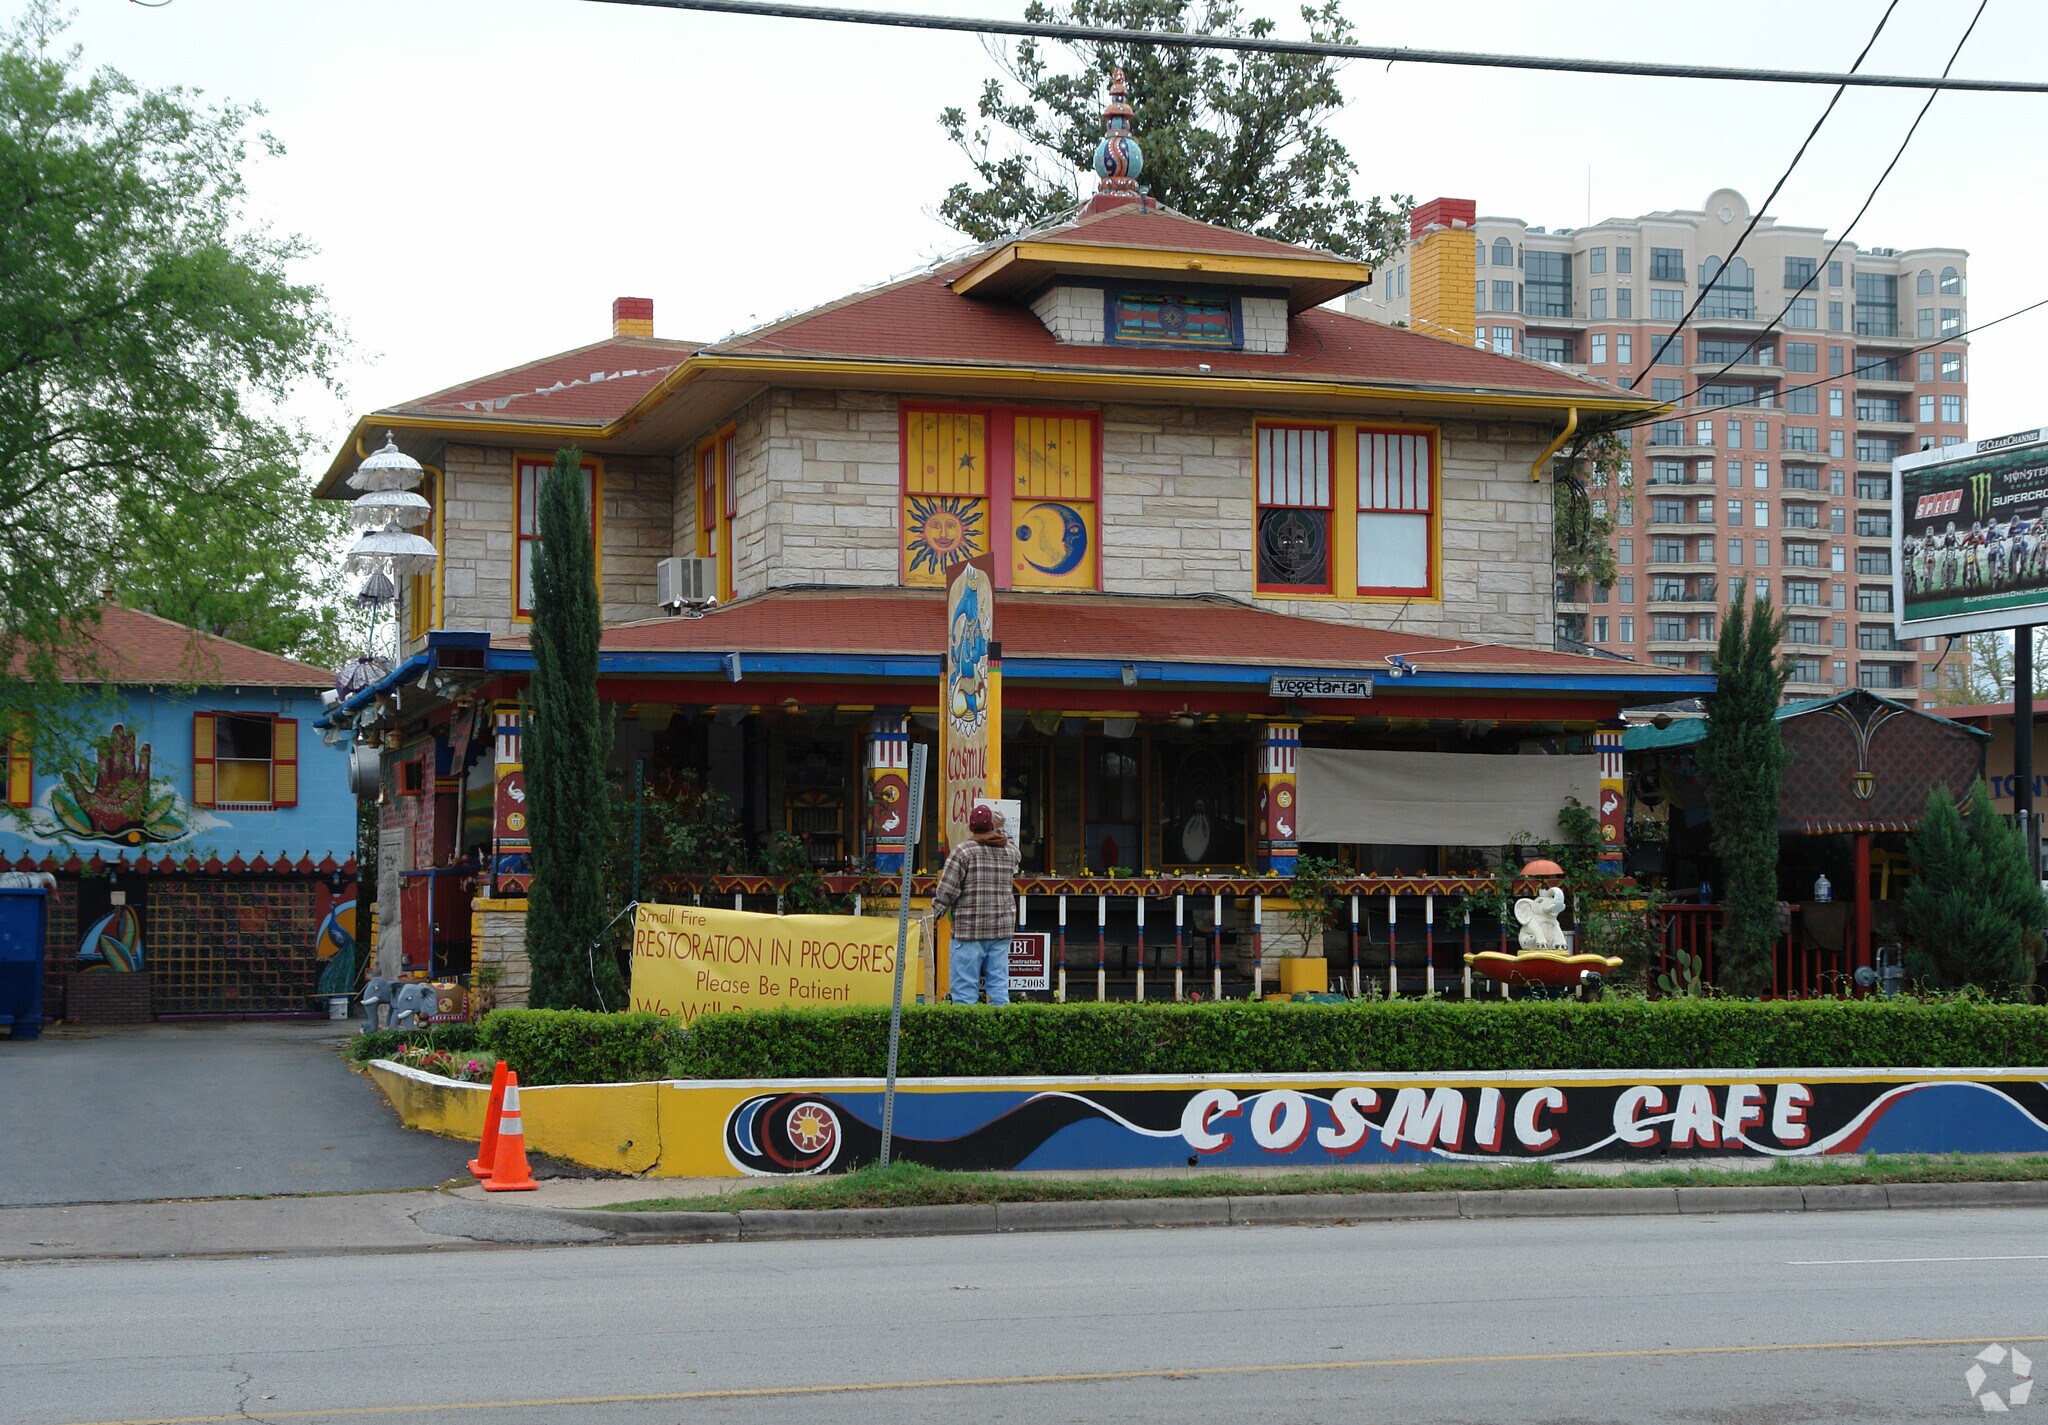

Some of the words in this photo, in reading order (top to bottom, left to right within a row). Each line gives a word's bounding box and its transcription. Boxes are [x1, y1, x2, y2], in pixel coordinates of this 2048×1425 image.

[1915, 494, 1961, 518] SPEED
[1277, 677, 1373, 697] vegetarian
[947, 745, 988, 782] COSMIC
[638, 907, 675, 925] Small
[681, 910, 707, 927] Fire
[636, 929, 762, 965] RESTORATION
[770, 938, 792, 967] IN
[800, 939, 905, 974] PROGRES
[696, 970, 750, 994] Please
[759, 975, 780, 996] Be
[789, 977, 850, 1001] Patient
[1180, 1086, 1566, 1153] COSMIC
[1612, 1083, 1815, 1150] CAFE
